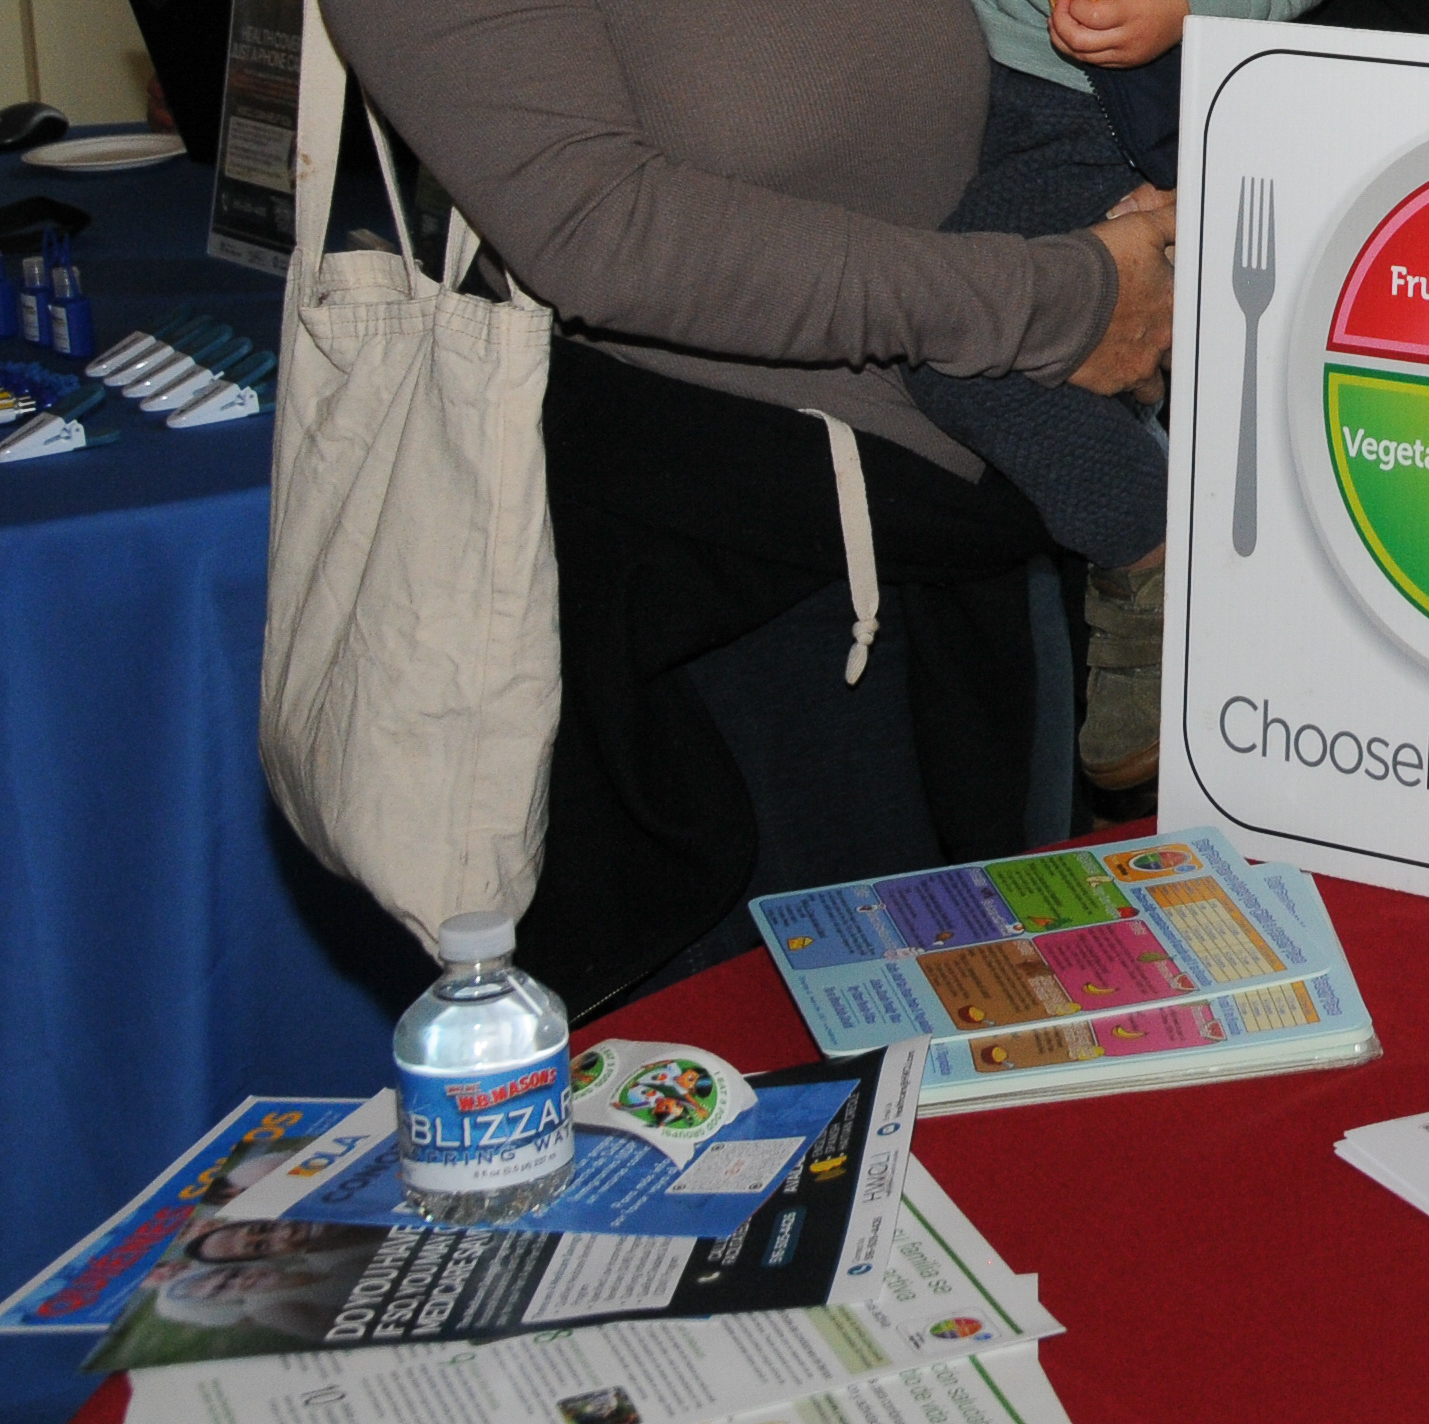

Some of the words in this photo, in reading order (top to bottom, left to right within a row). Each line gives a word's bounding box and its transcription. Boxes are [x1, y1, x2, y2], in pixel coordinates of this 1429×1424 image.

[411, 1087, 573, 1149] BLIZZAR
[533, 1125, 573, 1154] WAT
[179, 1110, 302, 1200] SOOS
[343, 1268, 400, 1311] YOU
[394, 1266, 439, 1299] YOU
[410, 1259, 479, 1338] MEDICARE
[325, 1307, 375, 1343] DO
